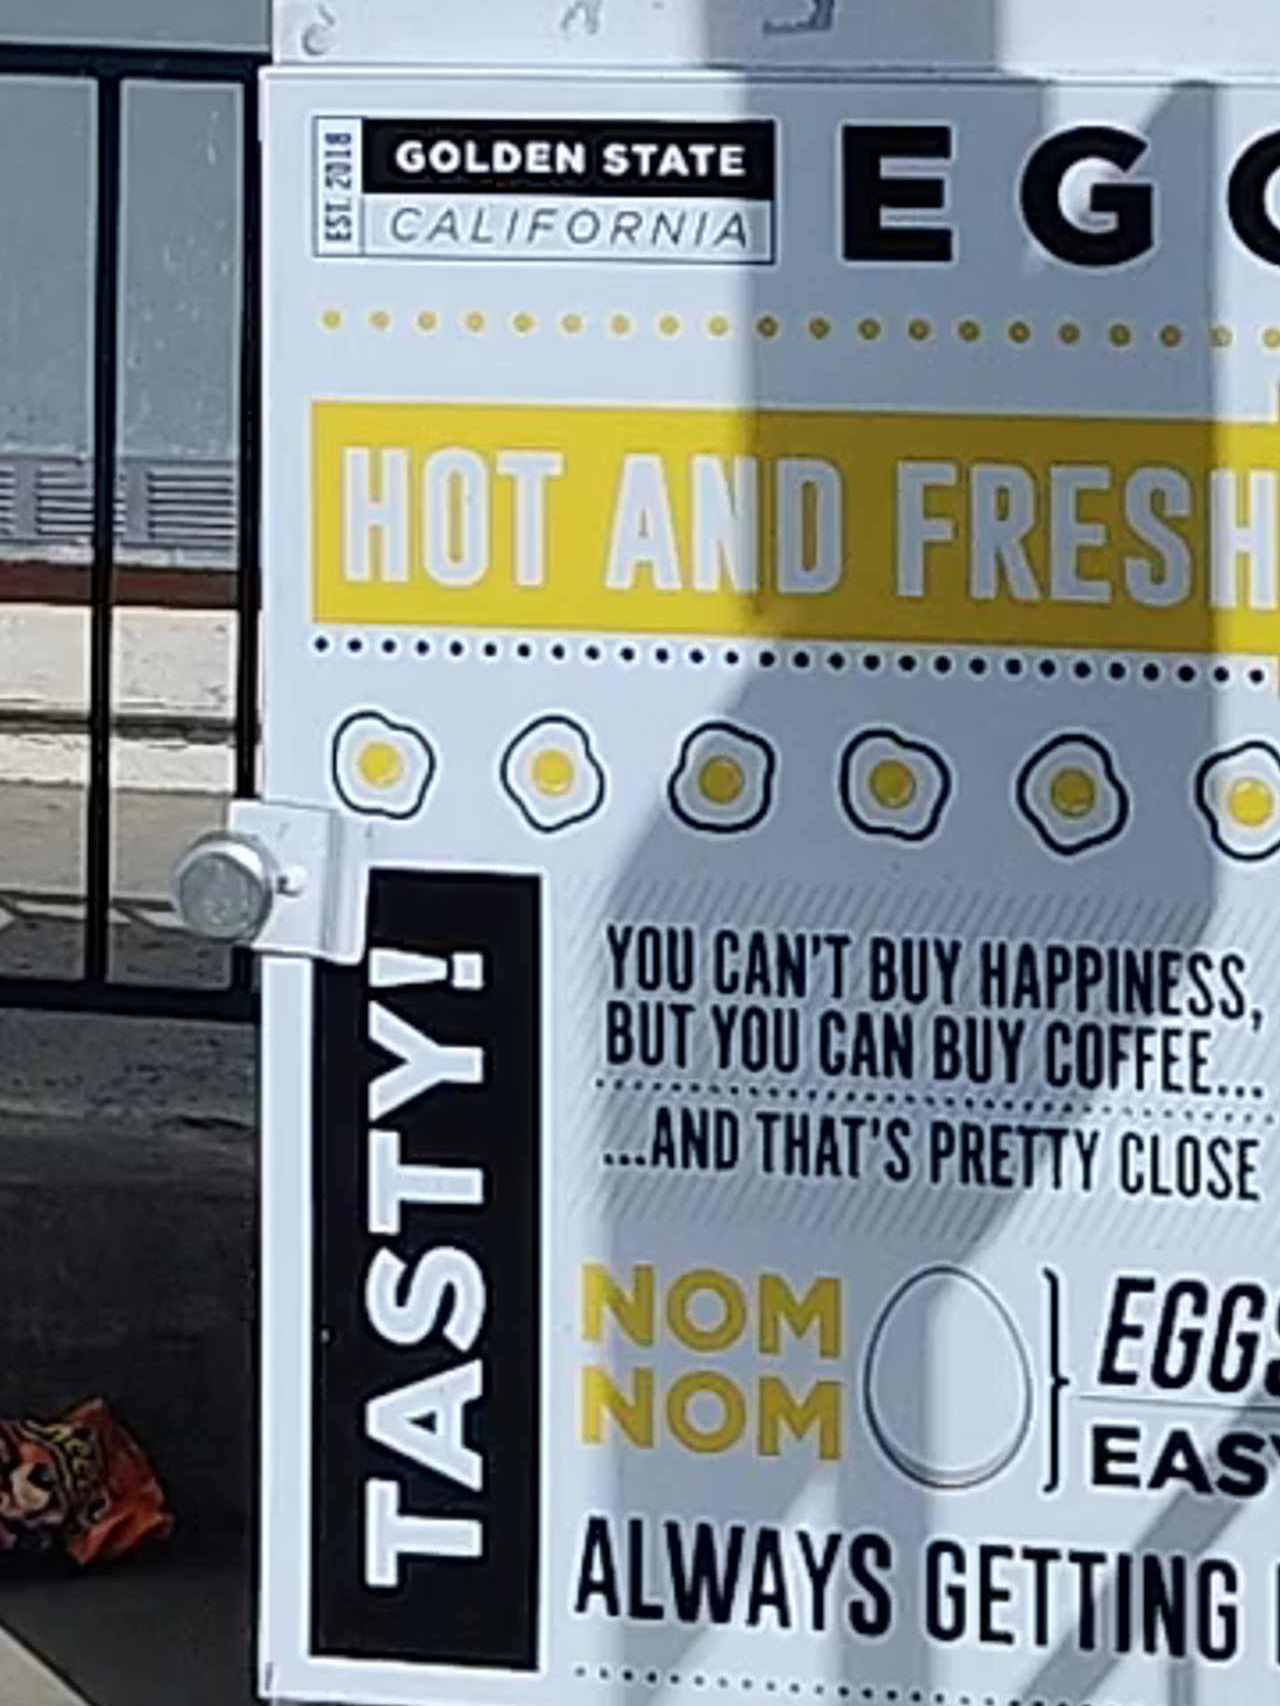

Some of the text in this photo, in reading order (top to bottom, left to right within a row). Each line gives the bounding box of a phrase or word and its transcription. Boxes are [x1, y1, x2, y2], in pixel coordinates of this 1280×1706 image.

[324, 132, 352, 190] 2018
[395, 140, 747, 177] GOLDEN STATE
[389, 206, 749, 249] CALIFORNIA
[340, 445, 1280, 612] HOT AND FRESH
[606, 924, 1264, 1032] YOU CAN'T BUY HAPPINESS,
[606, 1000, 1265, 1099] BUT YOU CAN BUY COFFEE...
[602, 1107, 1261, 1201] ...AND THAT'S PRETTY CLOSE
[365, 946, 487, 1587] TASTY!
[580, 1264, 842, 1359] NOM
[580, 1365, 842, 1461] NOM
[574, 1515, 891, 1638] ALWAYS
[924, 1540, 1238, 1662] GETTING
